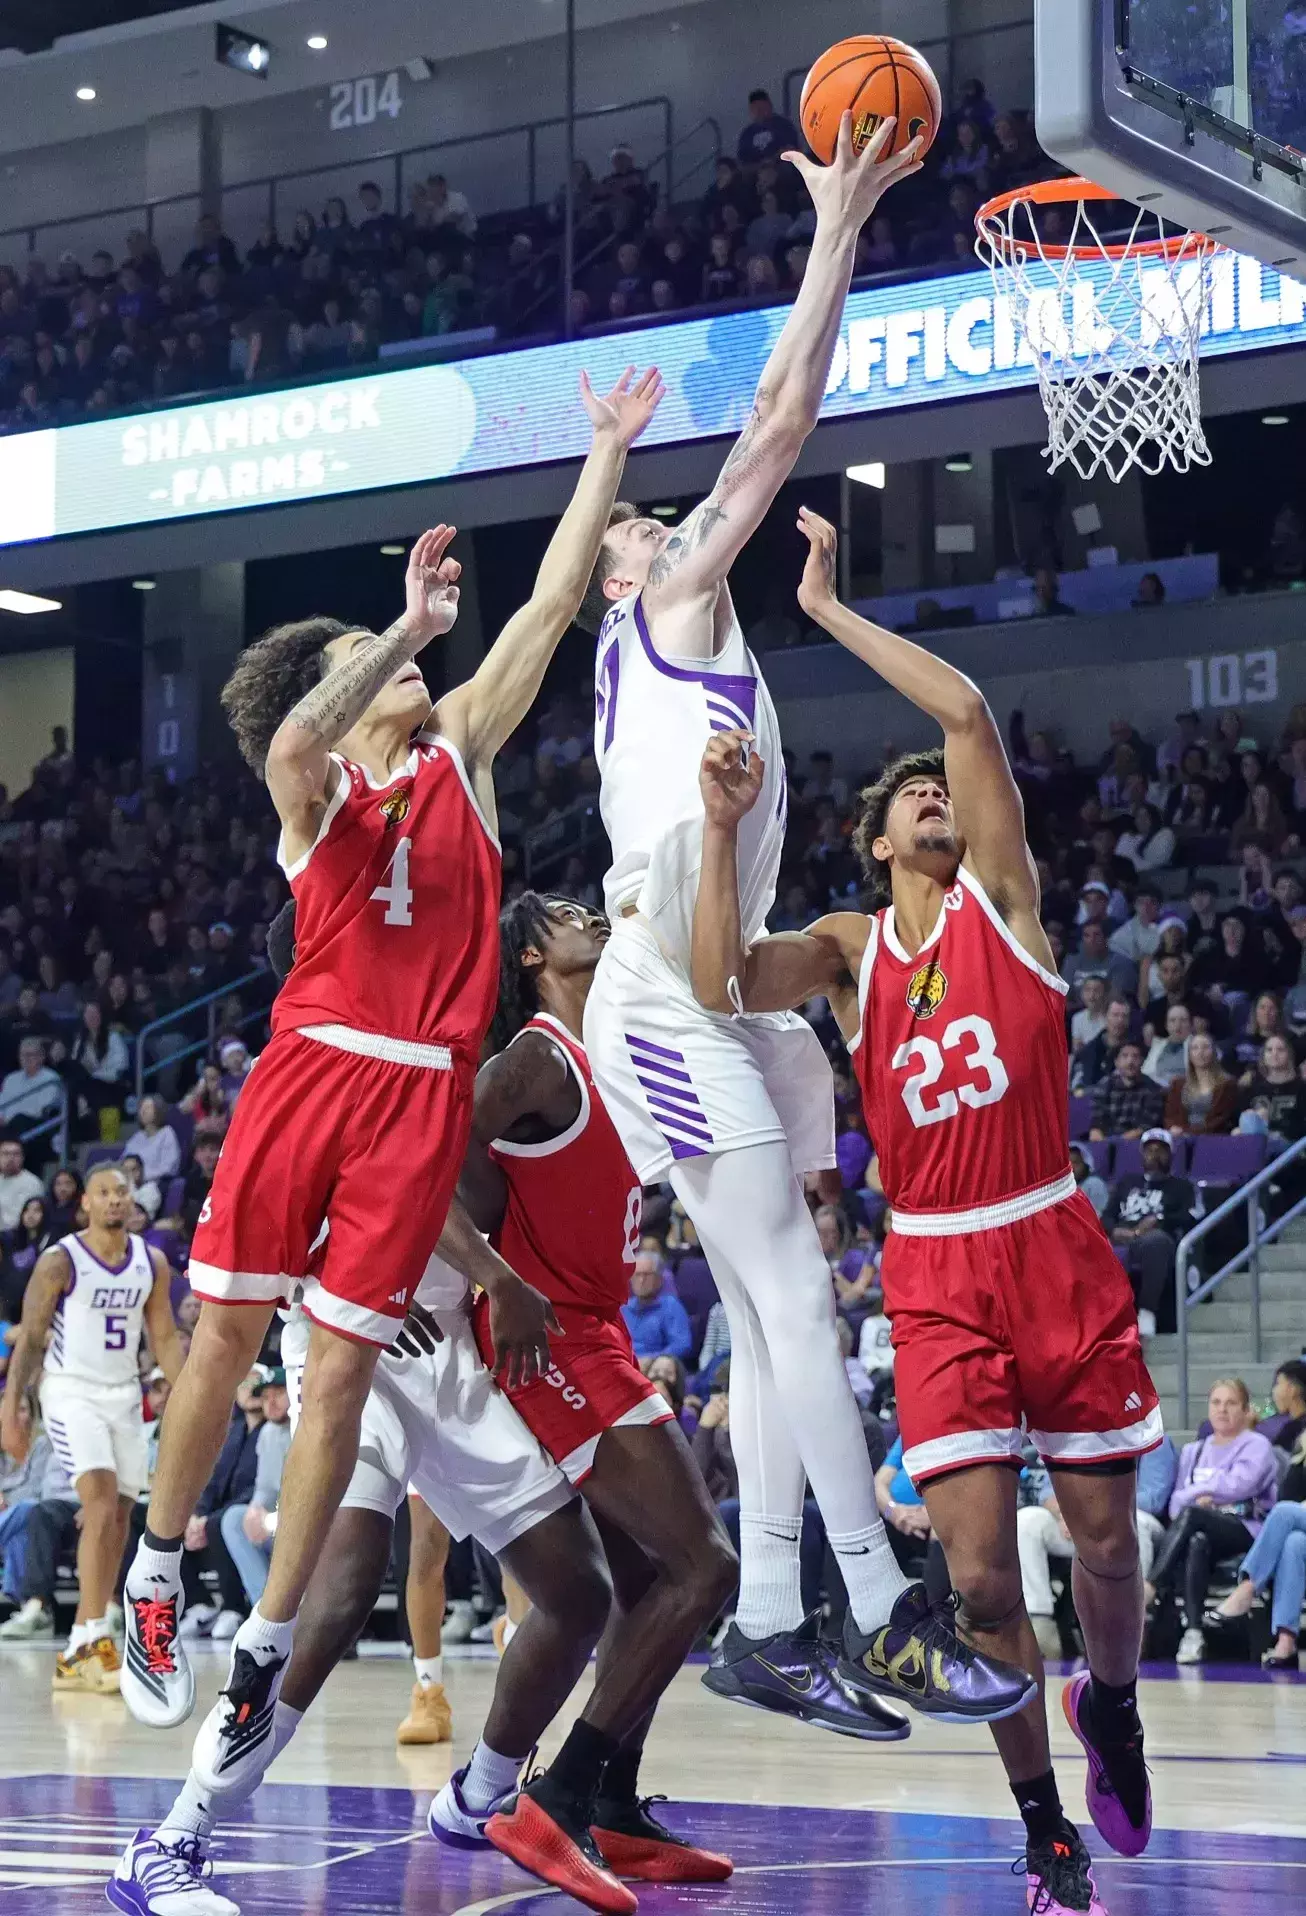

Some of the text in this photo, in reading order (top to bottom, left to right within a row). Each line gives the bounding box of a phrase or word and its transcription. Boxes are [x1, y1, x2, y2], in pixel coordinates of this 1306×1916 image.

[329, 72, 403, 131] 204
[121, 385, 381, 466] SHAMROCK
[1184, 650, 1278, 709] 103
[370, 836, 413, 927] 4
[892, 1014, 1010, 1129] 23
[90, 1288, 142, 1309] GCU
[105, 1314, 128, 1350] 5
